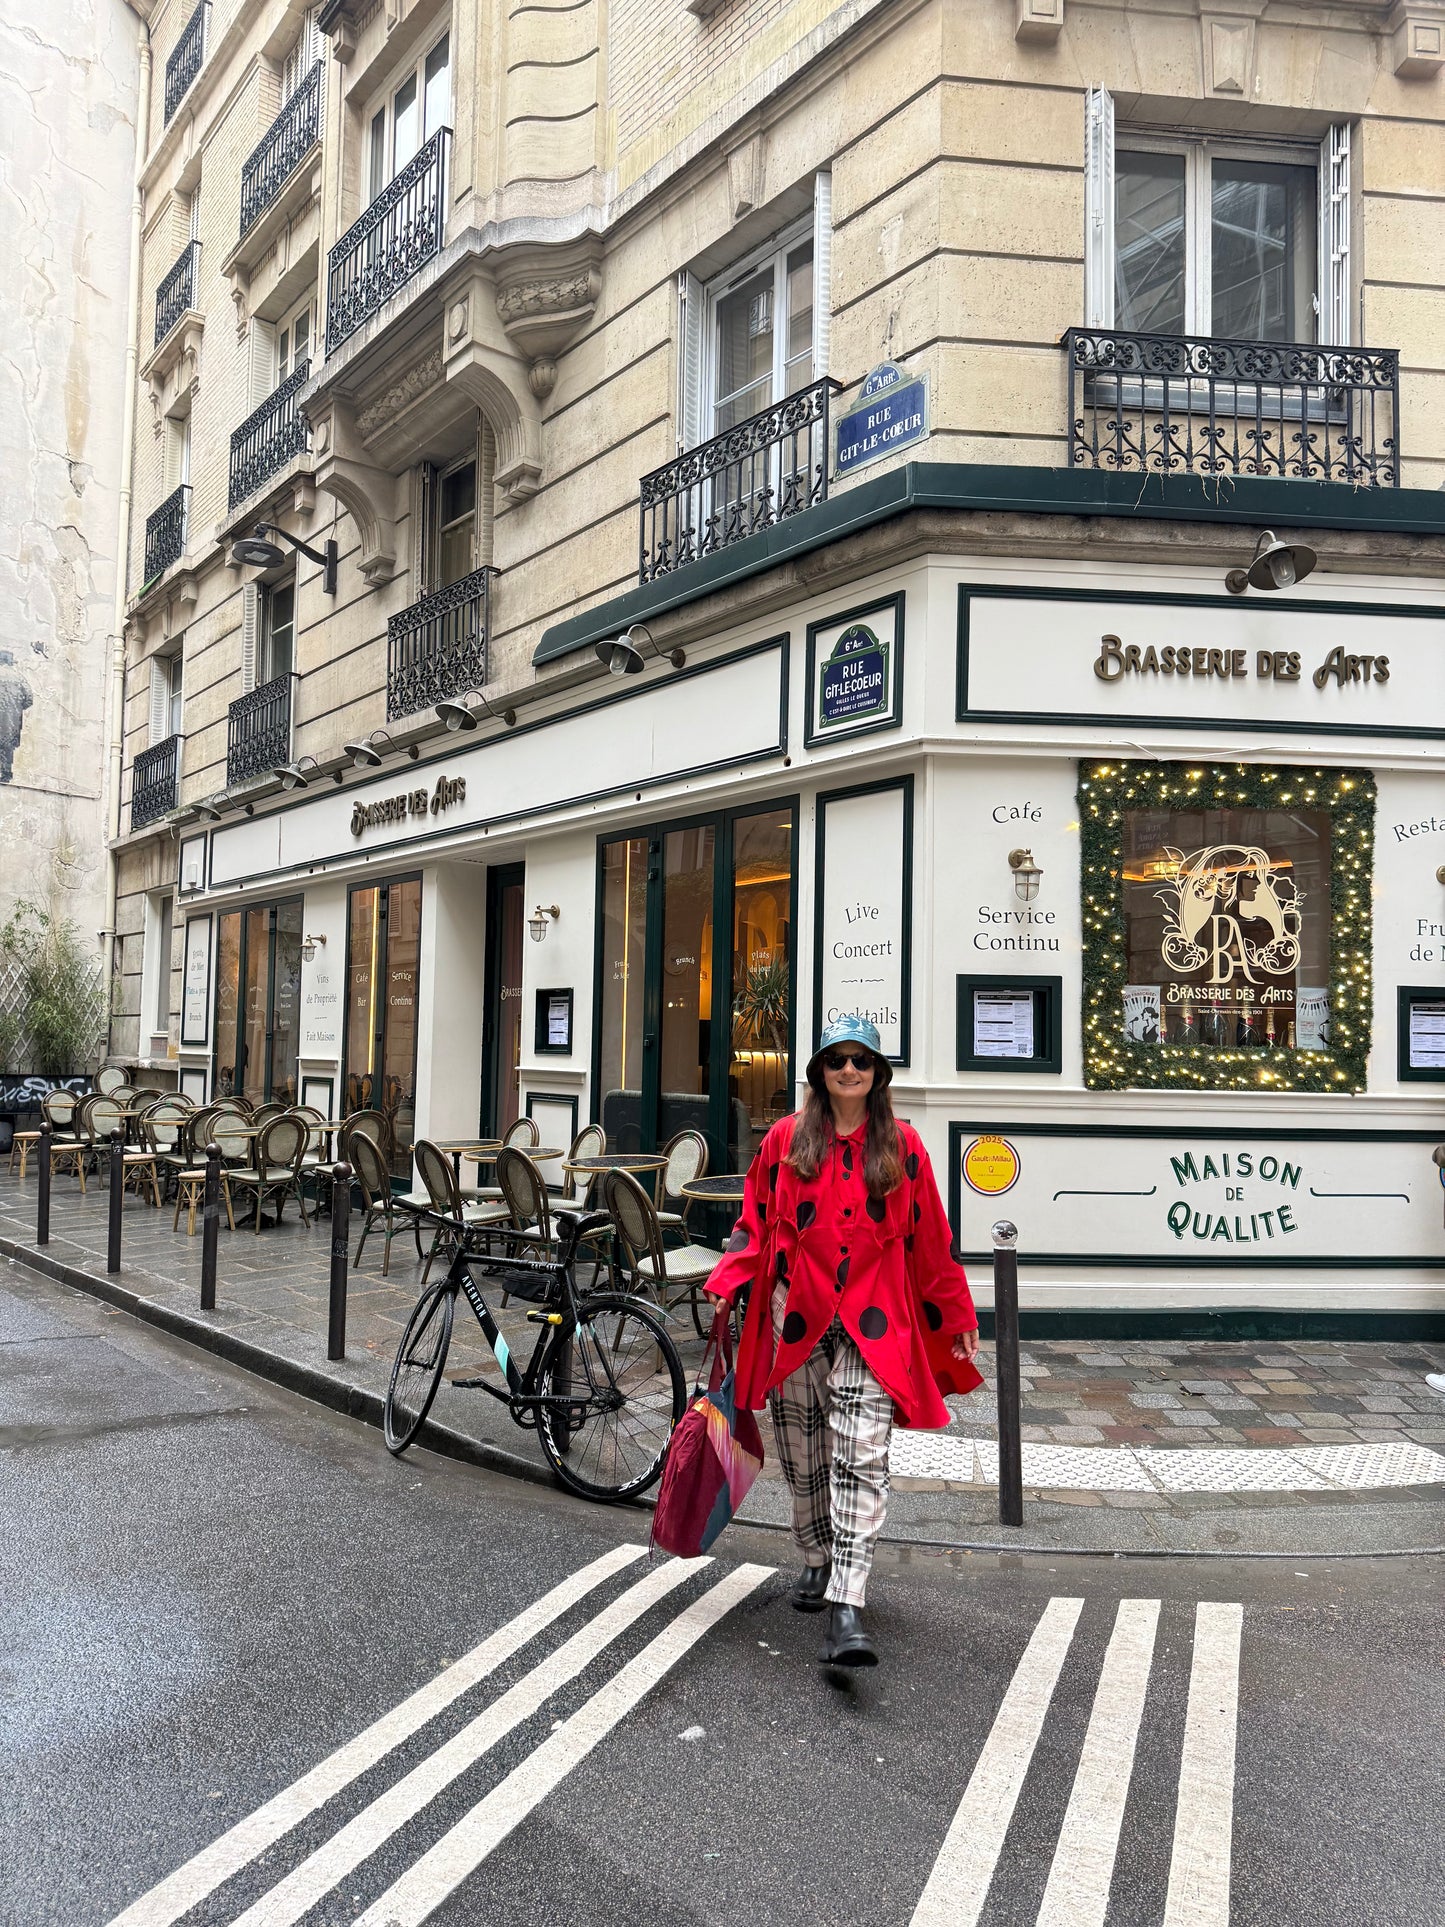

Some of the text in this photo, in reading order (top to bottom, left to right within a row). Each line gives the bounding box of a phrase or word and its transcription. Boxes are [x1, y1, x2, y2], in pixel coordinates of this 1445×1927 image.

[867, 406, 891, 430] RUE
[842, 660, 864, 679] RUE
[1094, 634, 1391, 690] BRASSERIE DES ARTS
[350, 775, 467, 837] BRASSERIE DES ARTS
[992, 801, 1042, 824] Café
[845, 902, 879, 924] Live
[978, 906, 1056, 924] Service
[833, 940, 892, 959] Concert
[973, 932, 1061, 951] Continu
[675, 956, 696, 966] Brunch
[751, 950, 770, 961] Plats
[1409, 943, 1434, 962] de
[316, 974, 330, 984] Vins
[355, 971, 369, 984] Café
[391, 970, 412, 982] Service
[306, 993, 337, 1006] de Propriété
[357, 997, 367, 1006] Bar
[390, 995, 413, 1006] Continu
[1166, 983, 1294, 1005] BRASSERIE DES ARTS
[306, 1031, 335, 1041] Fait Maison
[979, 1135, 1003, 1144] 2025
[1169, 1151, 1303, 1190] MAISON
[1225, 1187, 1244, 1201] DE
[461, 1275, 487, 1318] AVENTON
